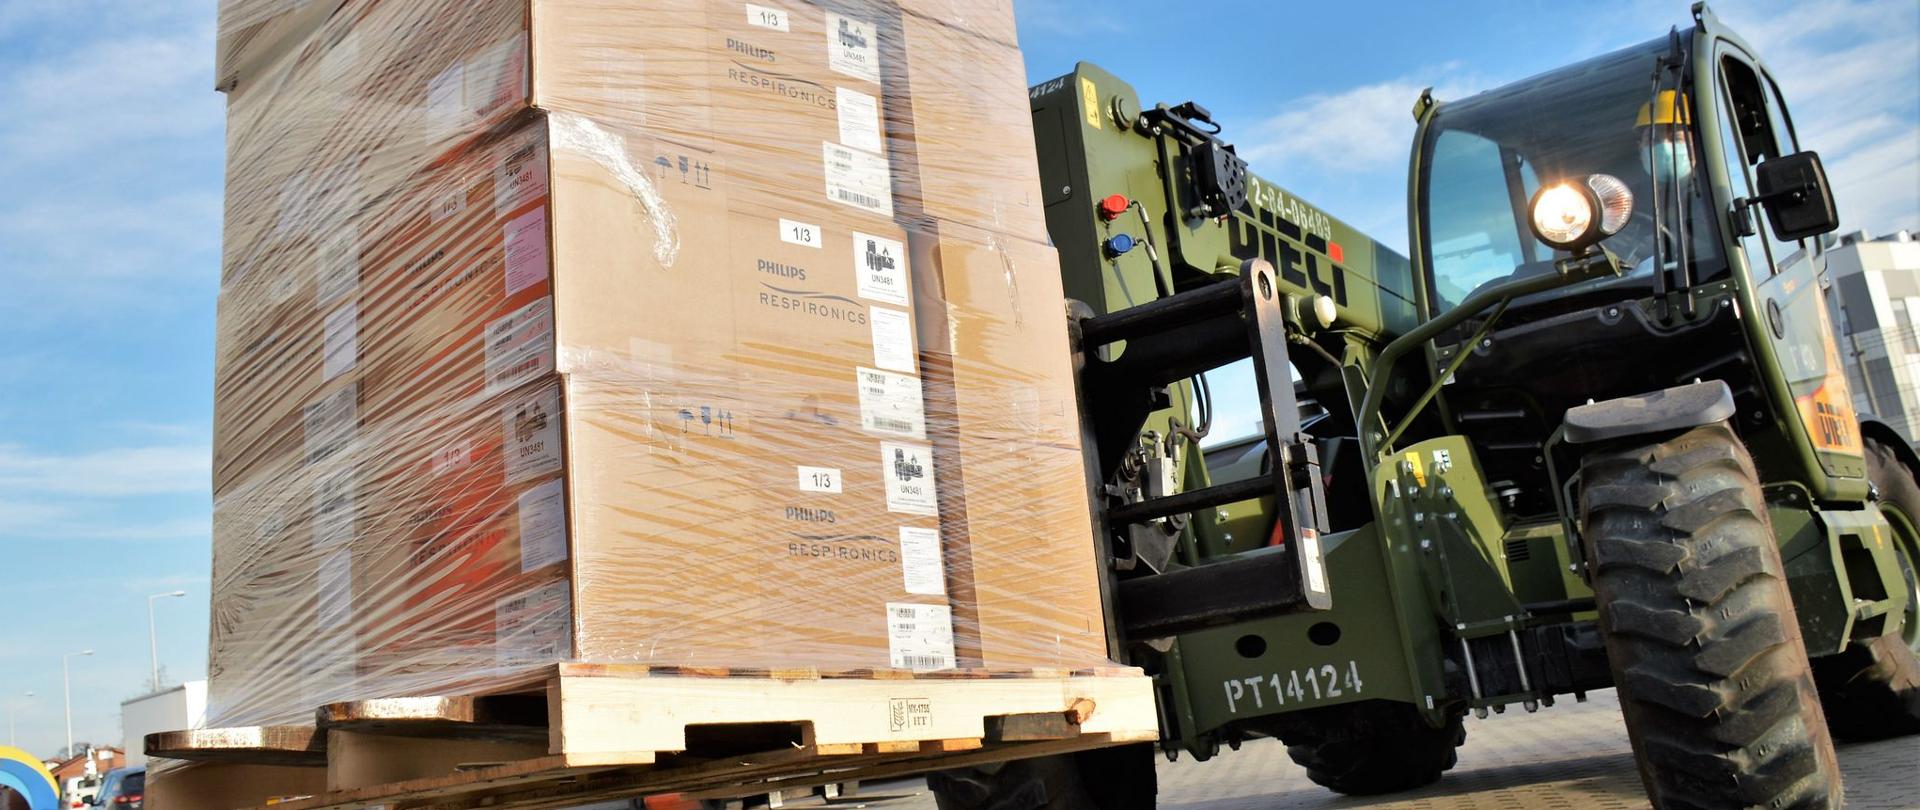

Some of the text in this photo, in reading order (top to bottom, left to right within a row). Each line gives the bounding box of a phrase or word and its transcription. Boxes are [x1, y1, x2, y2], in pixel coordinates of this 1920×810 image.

[760, 11, 778, 26] 1/3
[726, 38, 776, 62] PHILIPS
[728, 68, 836, 110] RESPIRONICS
[1252, 177, 1331, 240] 2-84-06489
[792, 226, 812, 243] 1/3
[1227, 198, 1348, 308] DIECI
[757, 259, 806, 281] PHILIPS
[871, 274, 894, 286] UN3481
[759, 291, 867, 325] RESPIRONICS
[812, 473, 832, 488] 1/3
[785, 506, 836, 524] PHILIPS
[788, 543, 898, 563] RESPIRONICS
[1223, 660, 1363, 713] PT14124
